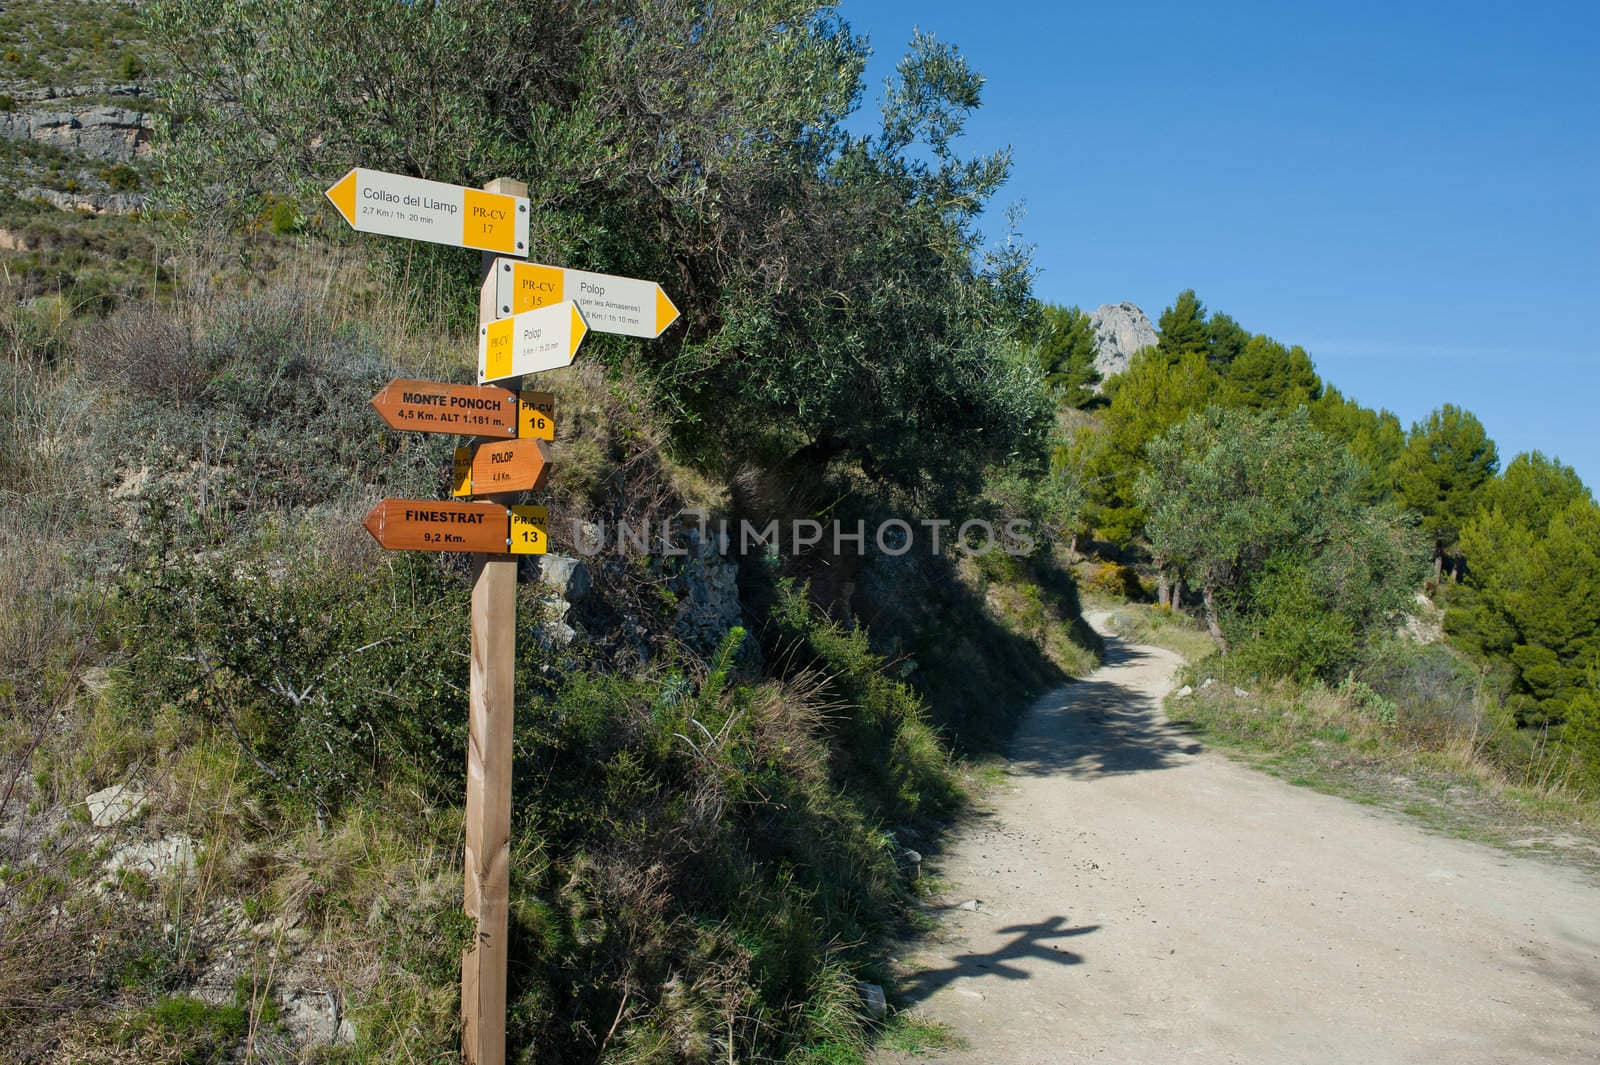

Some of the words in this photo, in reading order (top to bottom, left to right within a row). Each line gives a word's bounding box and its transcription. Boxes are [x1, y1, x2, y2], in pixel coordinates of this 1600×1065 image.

[363, 187, 400, 204] Collao
[403, 195, 420, 207] del
[423, 197, 458, 214] Llamp
[362, 206, 375, 216] 2,7
[396, 212, 405, 220] 1h
[409, 213, 419, 222] 20
[420, 215, 434, 225] min
[473, 206, 506, 221] PR-CV
[483, 223, 494, 234] 17
[522, 279, 555, 293] PR-CV
[580, 282, 606, 297] Polop
[532, 295, 543, 306] 15
[627, 317, 640, 325] min
[523, 328, 542, 342] Polop
[403, 392, 447, 406] MONTE
[450, 396, 501, 411] PONOCH
[398, 409, 414, 419] 4,5
[417, 411, 437, 421] Km.
[440, 413, 460, 422] ALT
[463, 414, 489, 425] 1.181
[493, 418, 505, 426] m.
[529, 418, 545, 429] 16
[491, 451, 514, 464] POLOP
[405, 510, 485, 525] FINESTRAT
[424, 532, 441, 543] 9,2
[444, 533, 466, 543] Km.
[522, 531, 539, 543] 13
